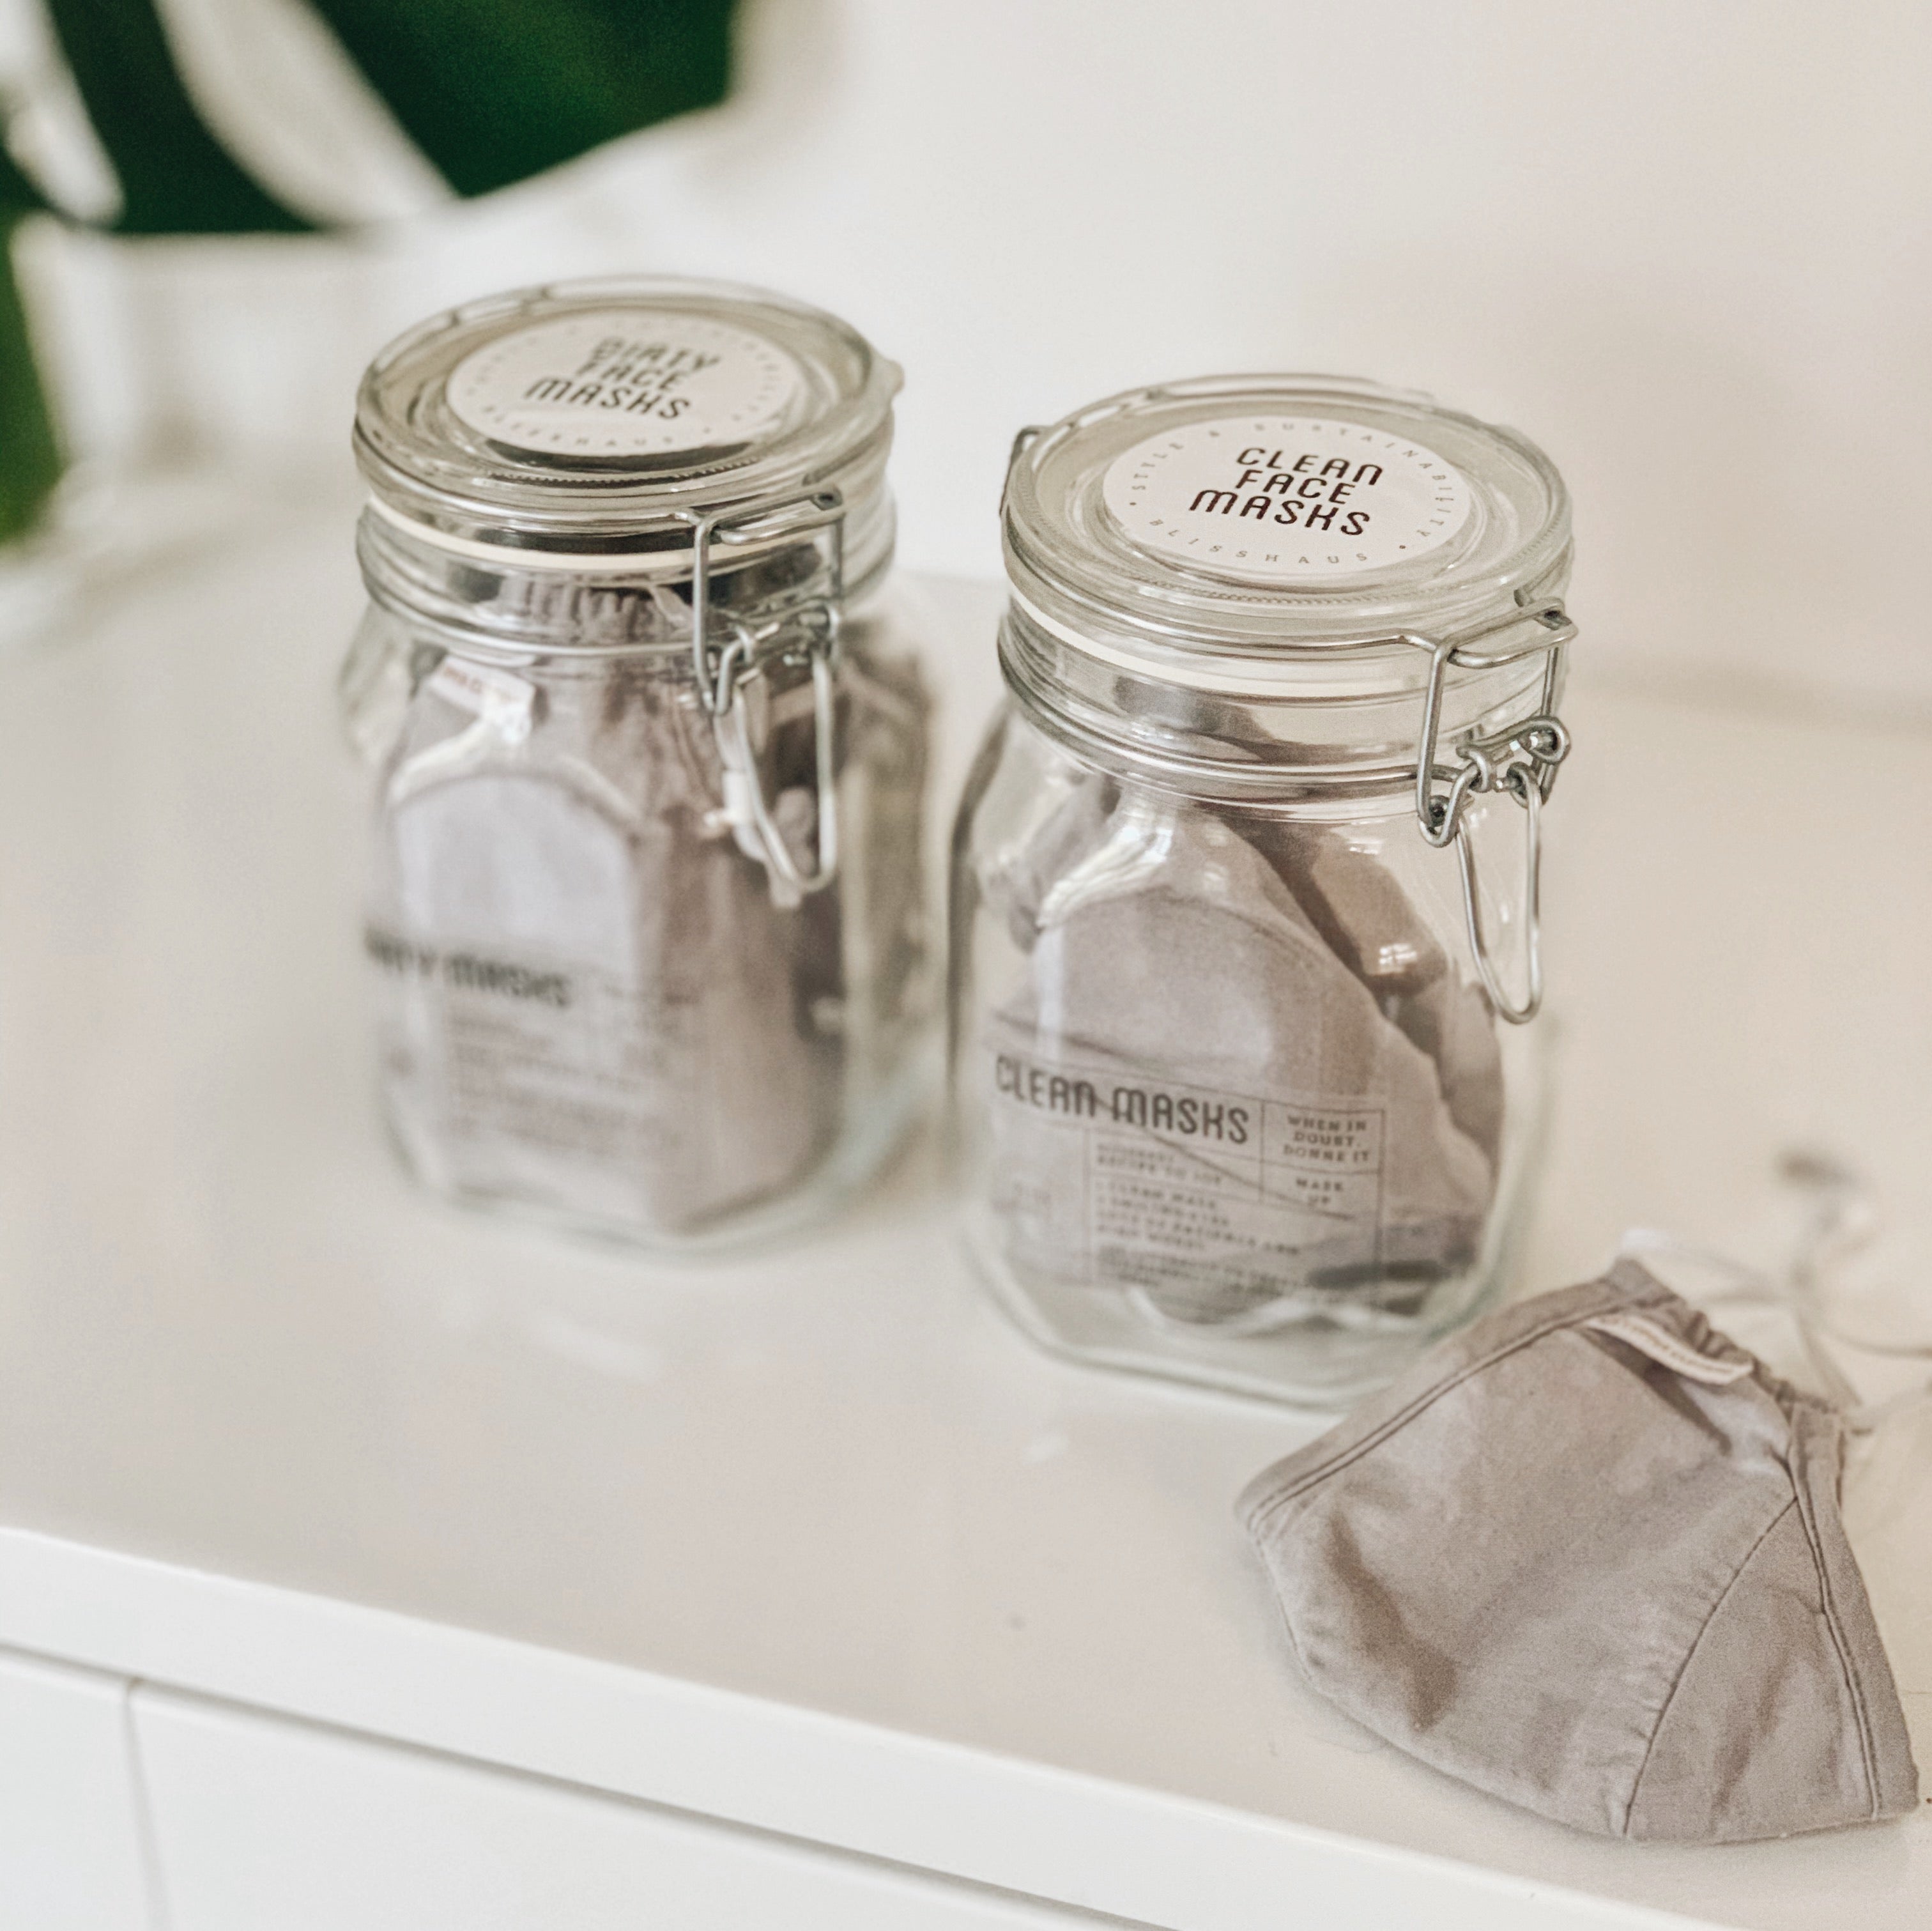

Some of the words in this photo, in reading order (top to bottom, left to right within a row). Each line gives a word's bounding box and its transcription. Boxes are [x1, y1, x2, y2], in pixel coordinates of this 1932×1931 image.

[524, 378, 689, 419] MASKS
[1131, 443, 1184, 491] STYLE
[1235, 468, 1355, 505] FACE
[1236, 447, 1383, 486] CLEAN
[1188, 489, 1370, 535] MASKS
[1149, 519, 1367, 565] BLISSHAUS
[996, 1055, 1097, 1118] CLEAN
[1112, 1086, 1249, 1145] MASKS
[1287, 1114, 1340, 1131] WHEN
